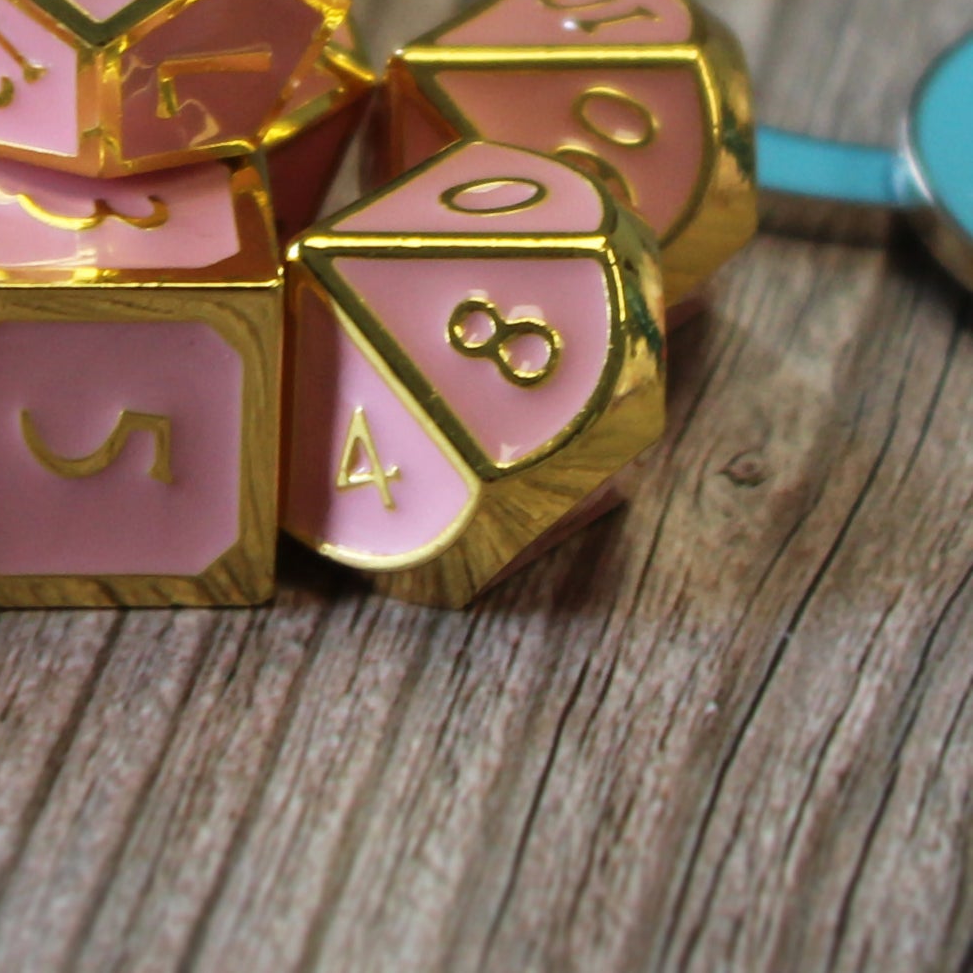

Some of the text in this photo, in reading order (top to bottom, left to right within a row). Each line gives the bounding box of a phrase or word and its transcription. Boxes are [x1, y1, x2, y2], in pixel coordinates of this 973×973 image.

[440, 176, 548, 215] 0
[446, 296, 561, 388] 8
[20, 407, 175, 485] 5
[336, 405, 402, 510] 4
